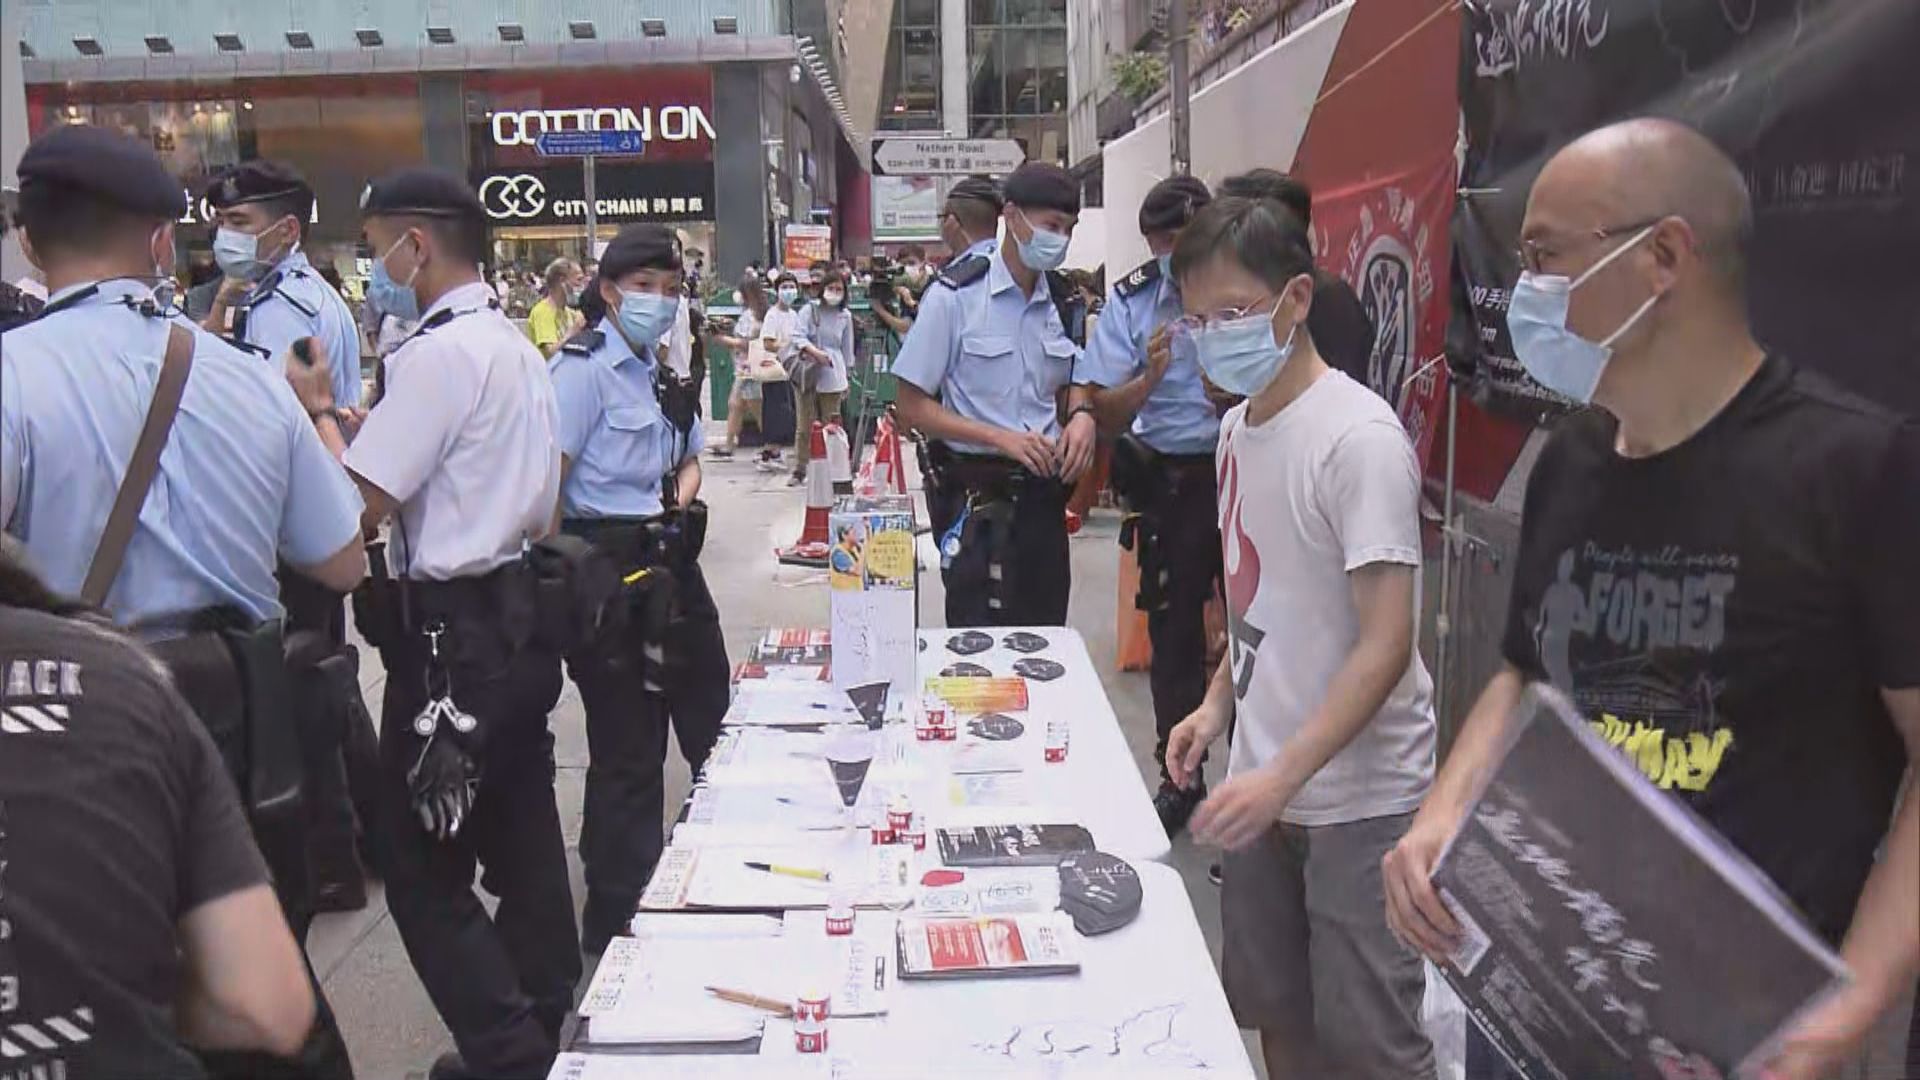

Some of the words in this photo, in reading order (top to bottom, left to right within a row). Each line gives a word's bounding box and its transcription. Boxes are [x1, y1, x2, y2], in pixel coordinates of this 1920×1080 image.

[916, 143, 954, 153] Nathan
[958, 143, 986, 153] Road
[595, 198, 648, 215] CHAIN
[1588, 572, 1735, 652] FORGET
[0, 659, 83, 696] ACK
